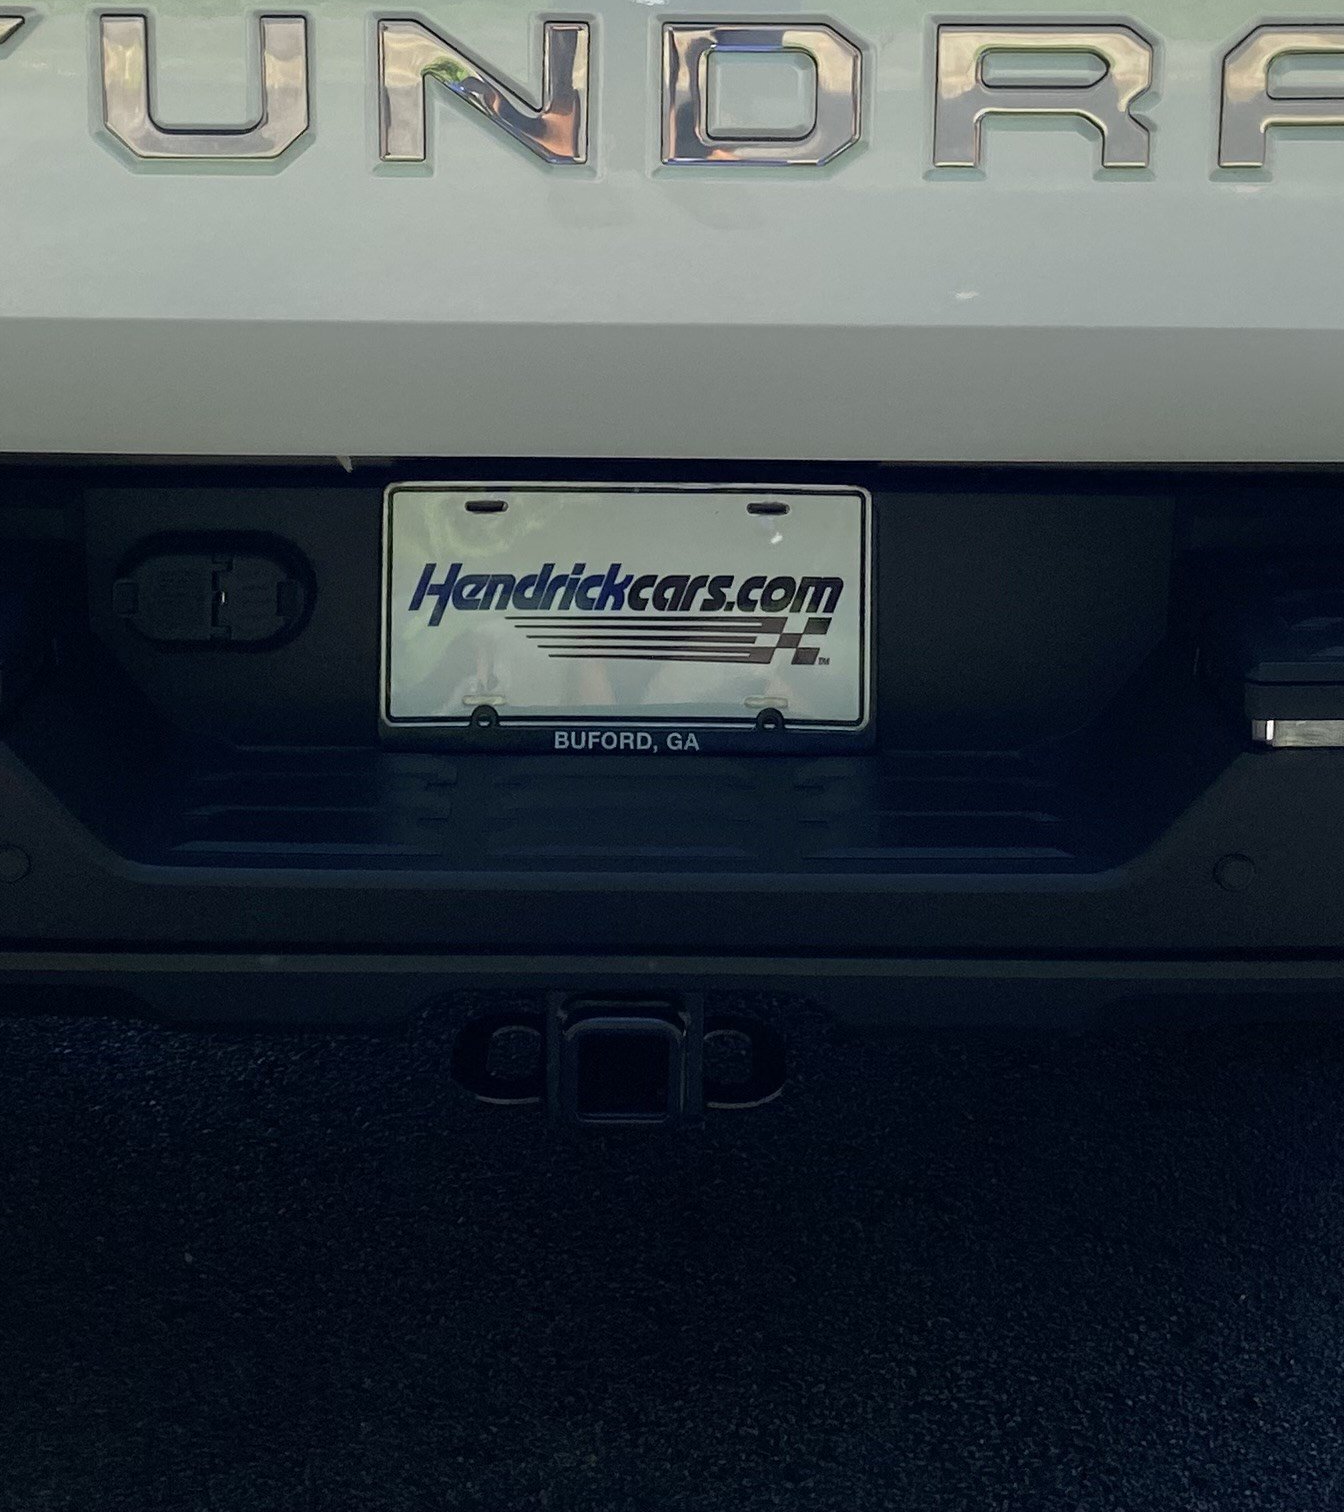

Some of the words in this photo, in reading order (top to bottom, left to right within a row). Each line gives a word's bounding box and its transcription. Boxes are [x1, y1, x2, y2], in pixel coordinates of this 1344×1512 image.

[407, 562, 845, 627] Hendrickcars.com
[554, 731, 658, 754] BUFORD,
[666, 731, 701, 752] GA
